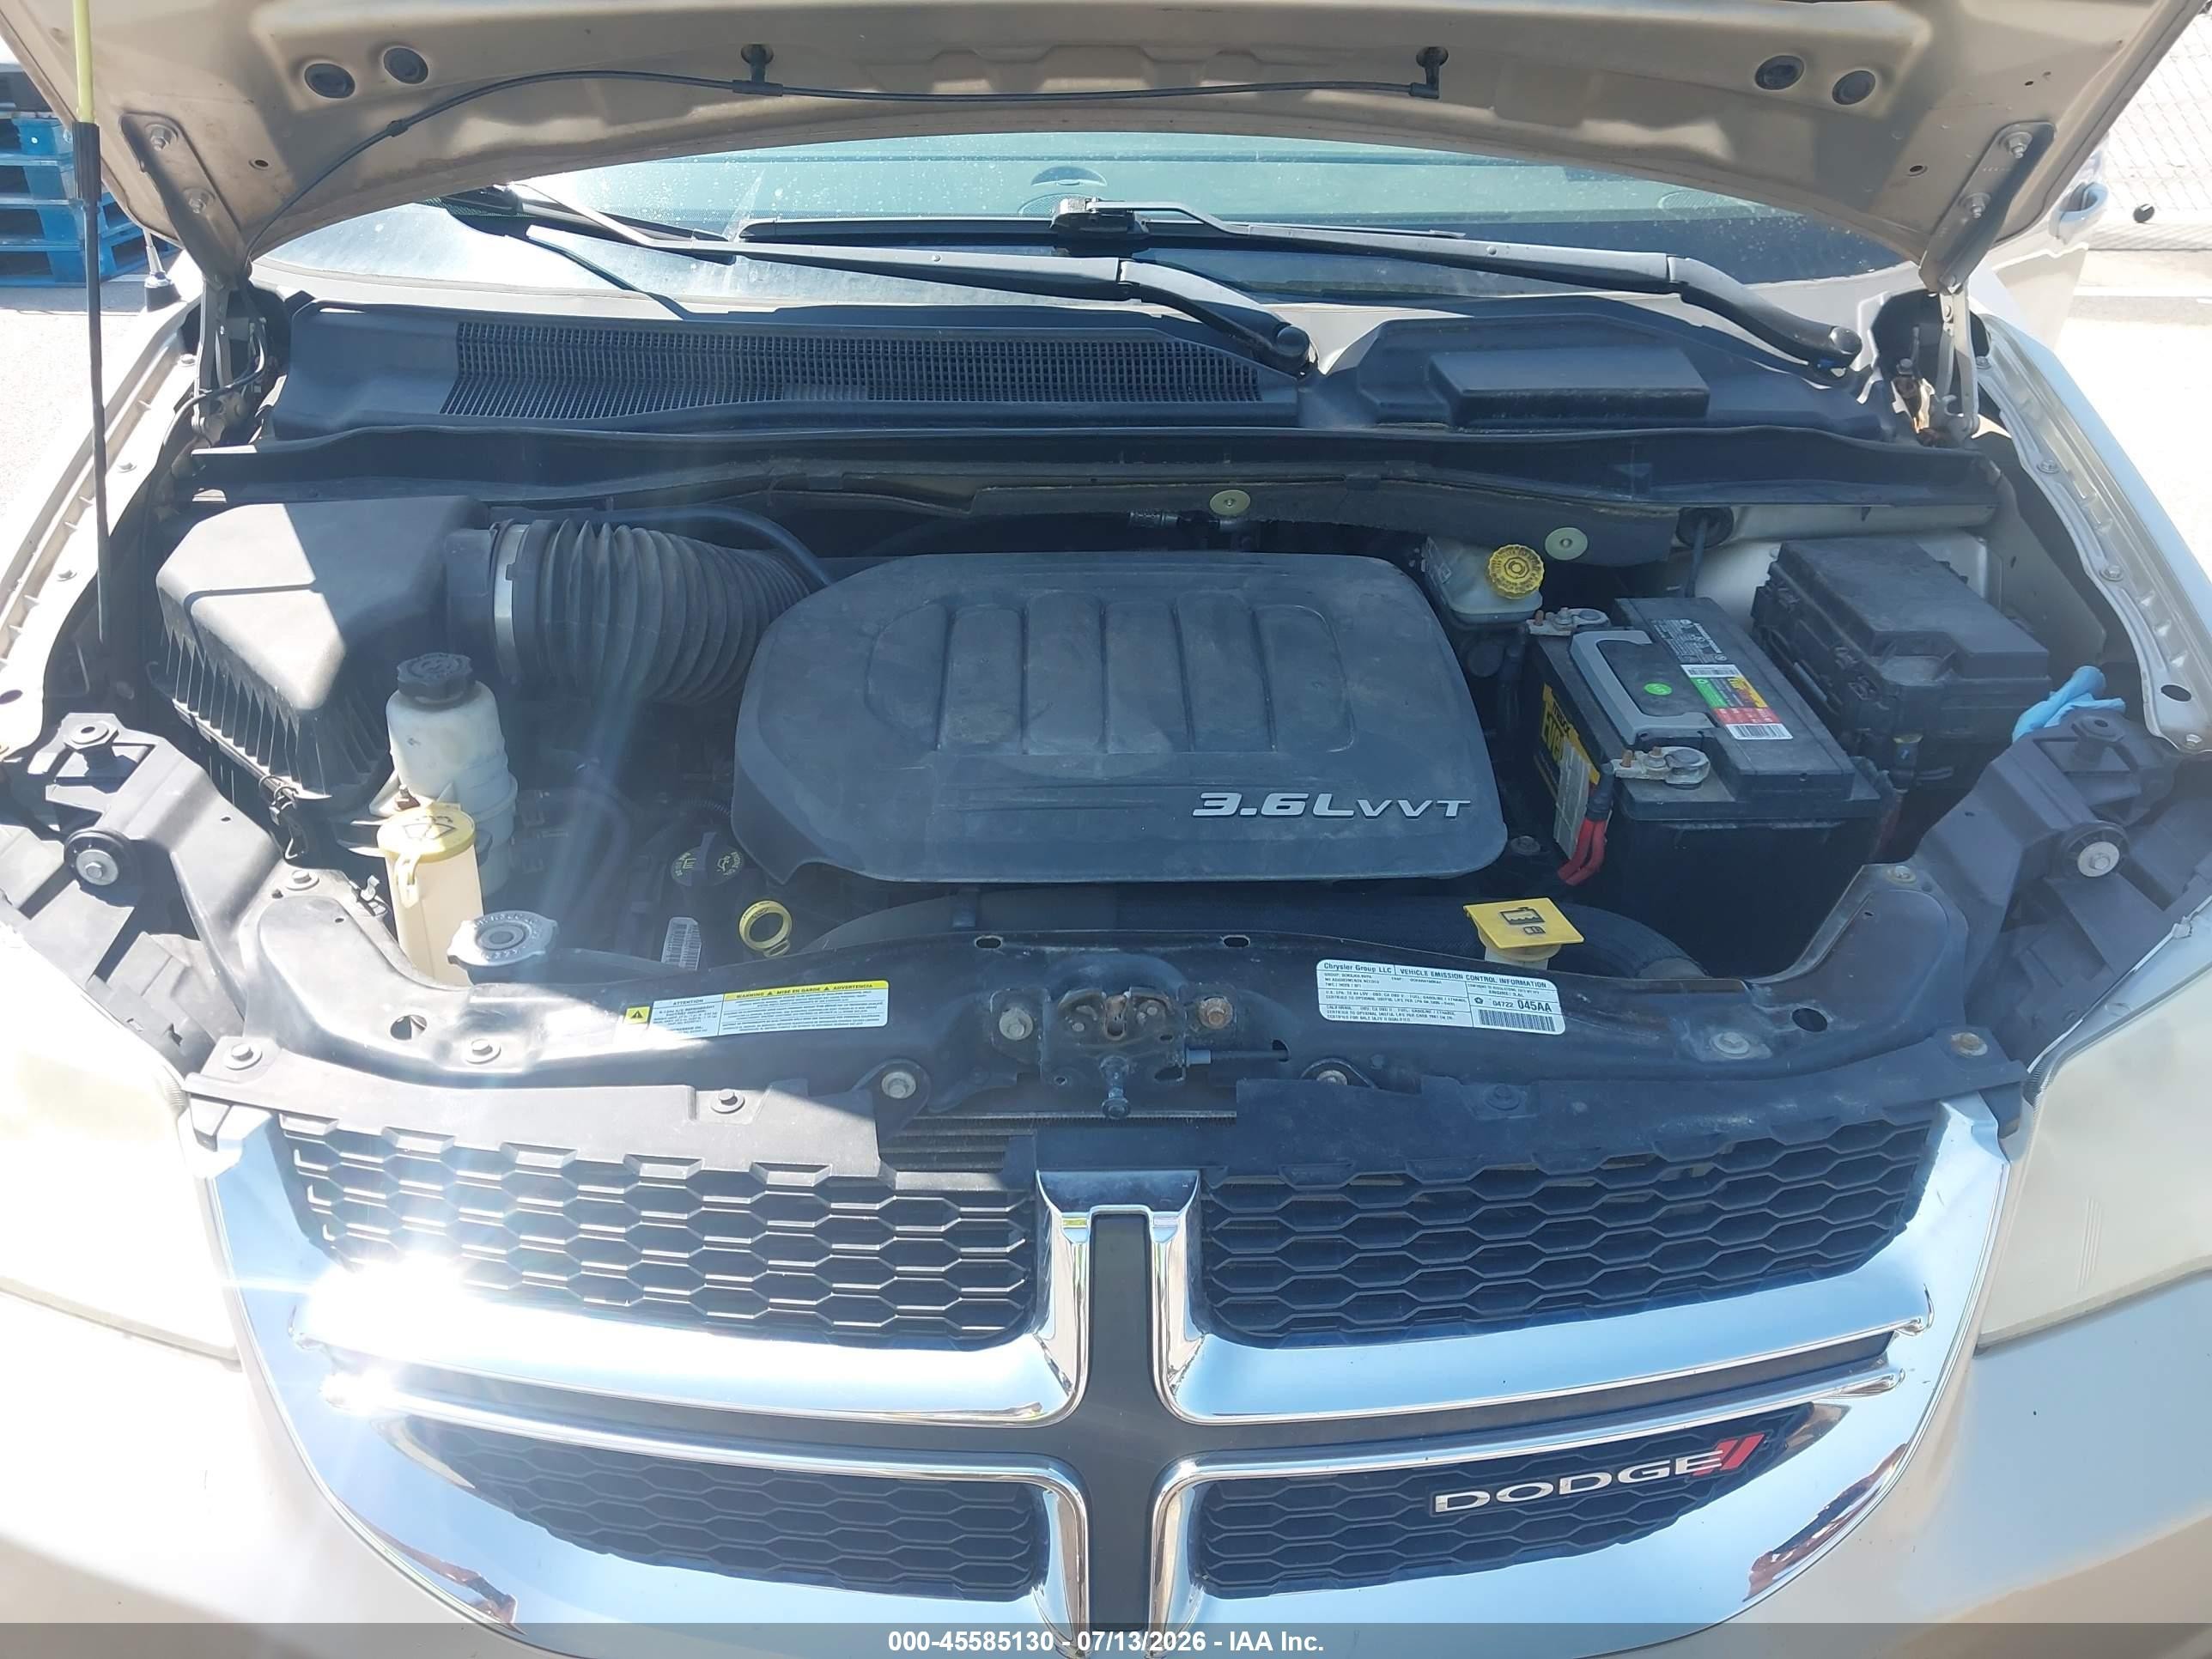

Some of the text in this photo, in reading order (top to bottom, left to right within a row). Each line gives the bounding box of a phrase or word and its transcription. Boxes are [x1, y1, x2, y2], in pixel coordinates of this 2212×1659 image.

[1193, 792, 1471, 817] 3.6L VVT
[1323, 962, 1352, 971] Chrysler
[1355, 964, 1376, 973] Group
[1400, 968, 1547, 988] VEHICLE EMISSION CONTROL INFORMATION
[1492, 1000, 1553, 1012] 04722 045AA
[1435, 1449, 1724, 1513] DODGE
